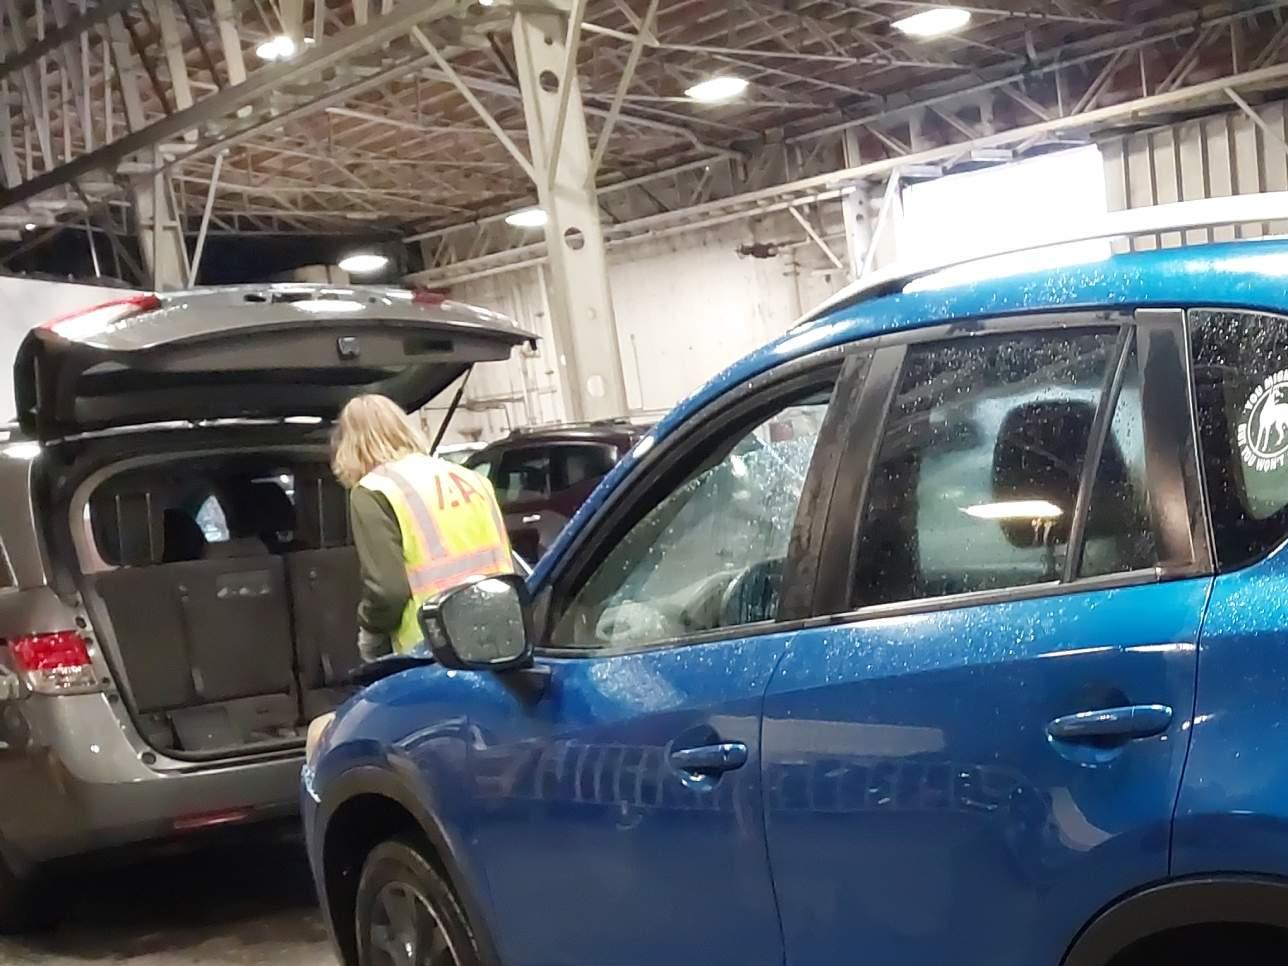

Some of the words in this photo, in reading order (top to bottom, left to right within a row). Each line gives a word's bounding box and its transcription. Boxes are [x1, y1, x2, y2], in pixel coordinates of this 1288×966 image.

[1245, 385, 1263, 410] YOU
[1241, 446, 1257, 466] YOU
[1256, 456, 1284, 472] WON'T
